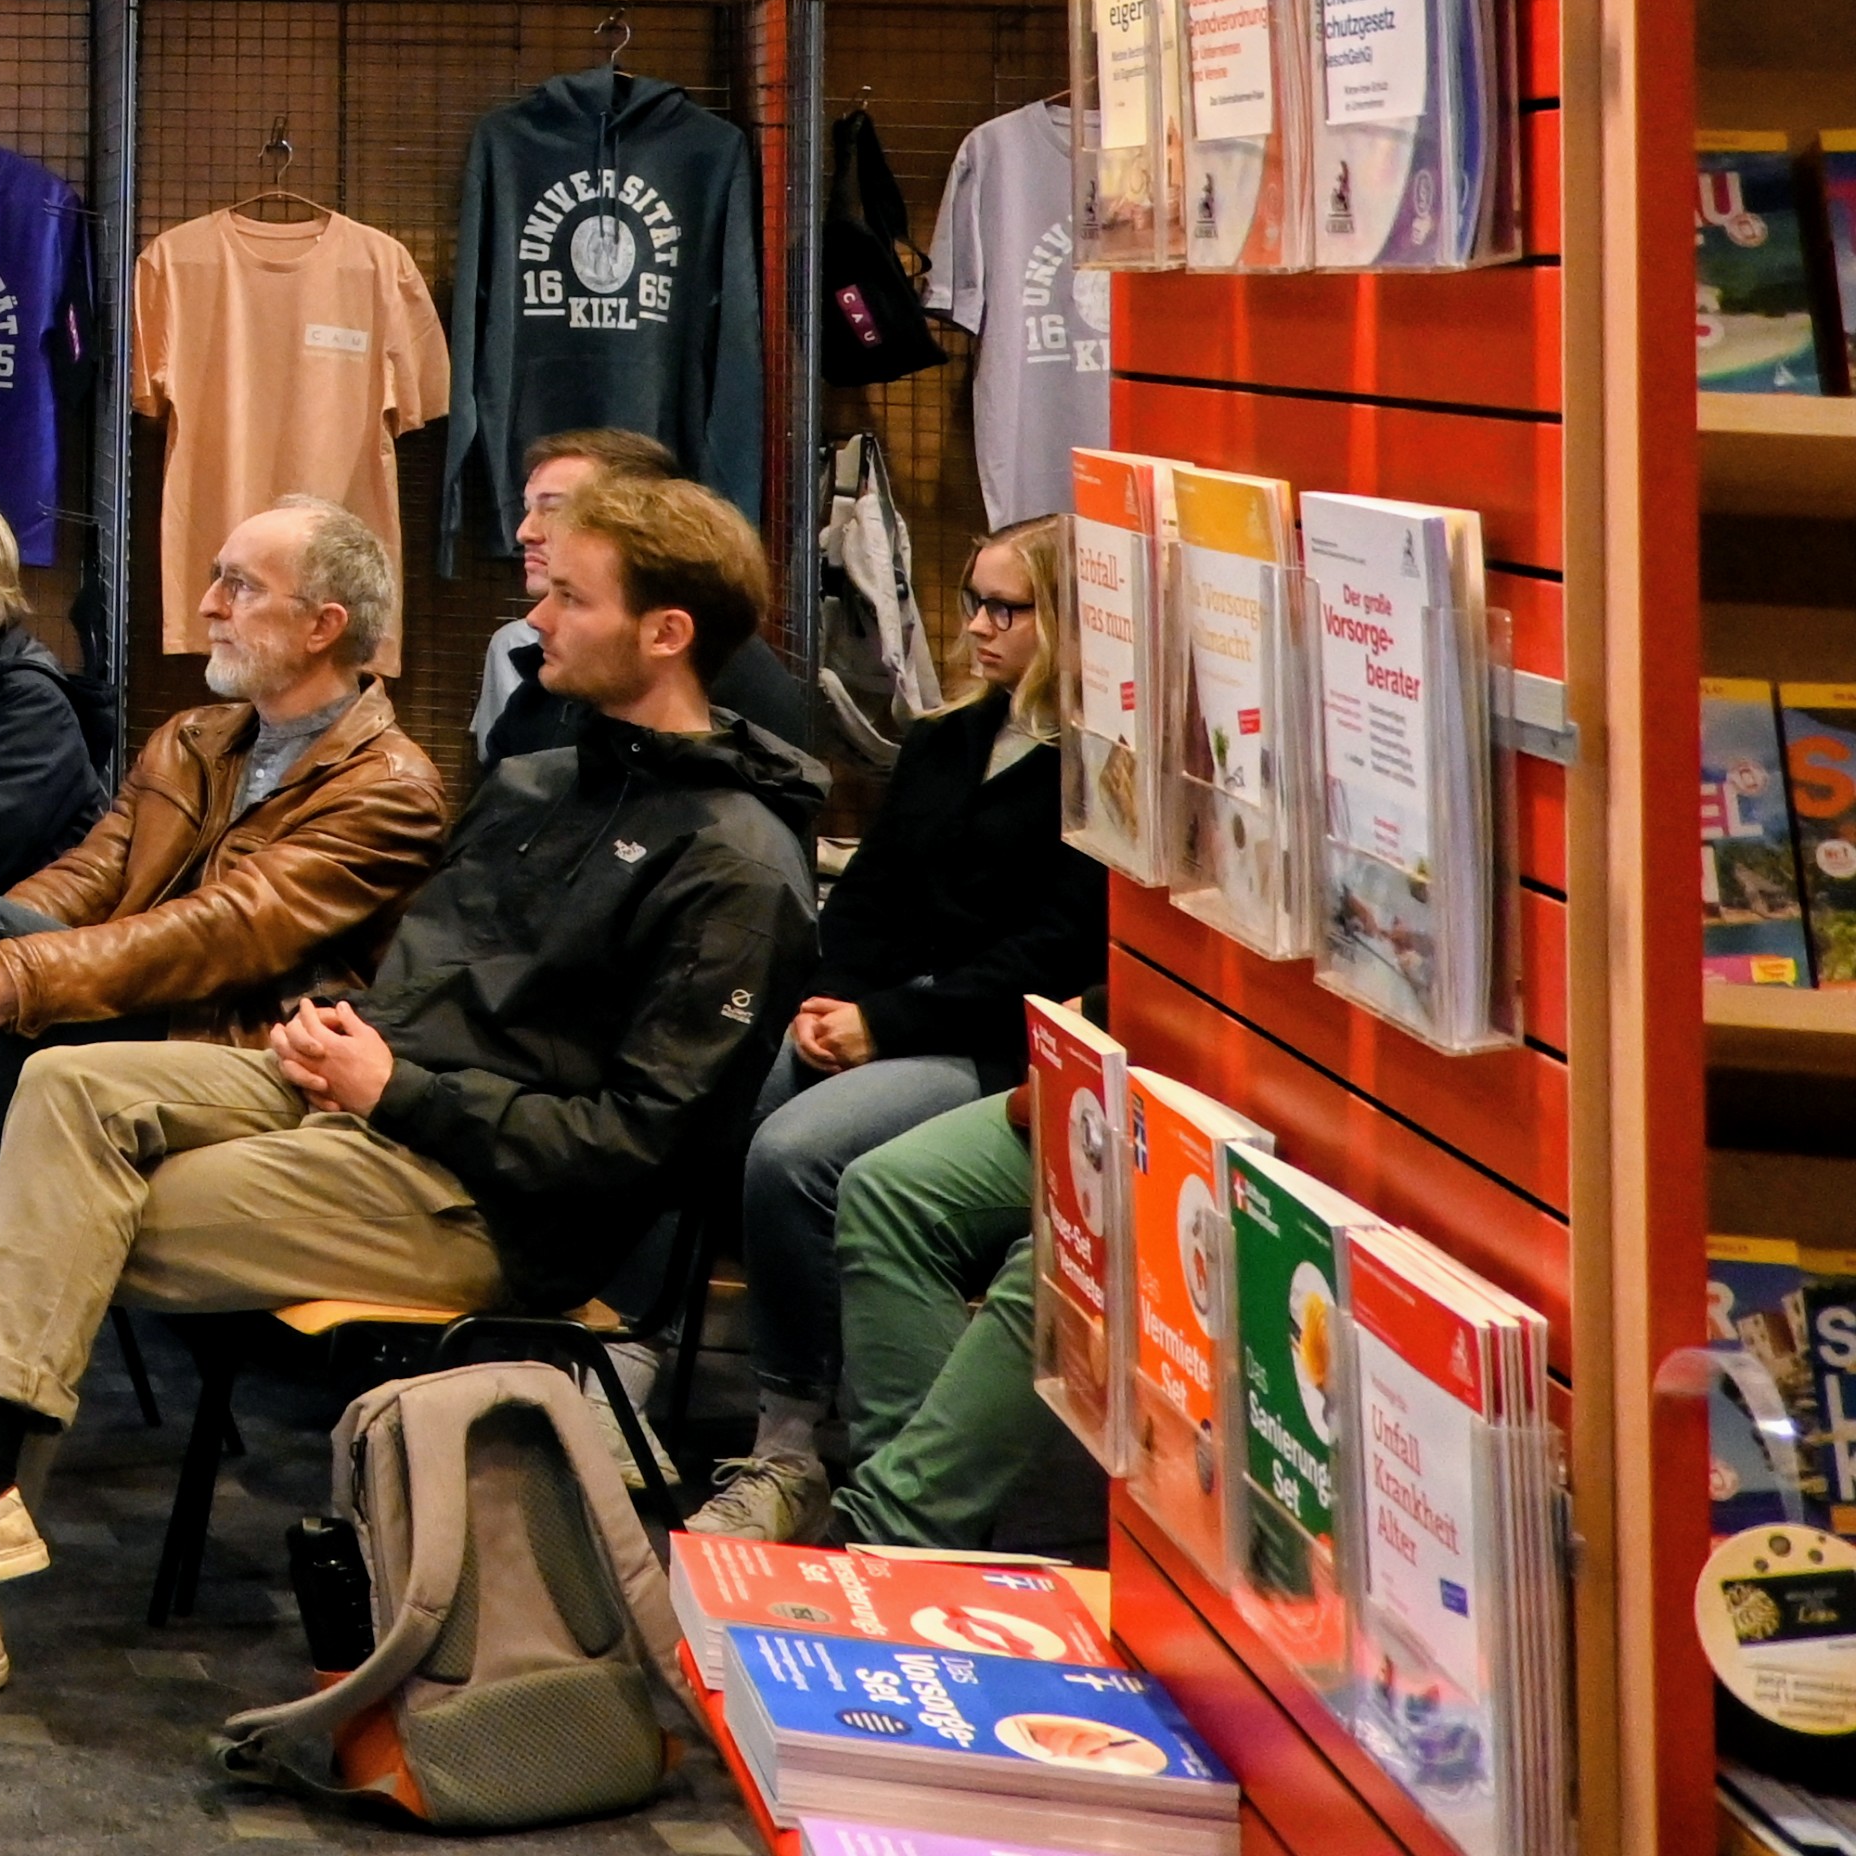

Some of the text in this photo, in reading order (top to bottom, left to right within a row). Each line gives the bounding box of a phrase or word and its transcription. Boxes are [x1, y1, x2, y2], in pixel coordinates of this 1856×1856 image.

[1315, 8, 1396, 43] schutzgesetz
[1200, 43, 1242, 60] Unternehmen
[1203, 66, 1228, 82] Vereine
[519, 168, 682, 267] UNIVERSITÄT
[523, 269, 673, 310] 16 65
[568, 297, 637, 330] KIEL
[1025, 314, 1066, 351] 16
[1079, 547, 1125, 591] Erbfall-
[1343, 583, 1392, 617] Der große
[1322, 603, 1395, 657] Vorsorge-
[1366, 654, 1421, 701] berater
[1140, 1296, 1210, 1392] Vermiete
[1159, 1361, 1188, 1414] Set
[1246, 1345, 1268, 1395] Das
[1372, 1403, 1422, 1477] Unfall
[1273, 1458, 1301, 1519] Set
[1372, 1451, 1460, 1556] Krankheit
[1377, 1505, 1418, 1567] Alter
[798, 1561, 834, 1584] Set
[855, 1666, 912, 1706] Set
[941, 1655, 980, 1686] Das
